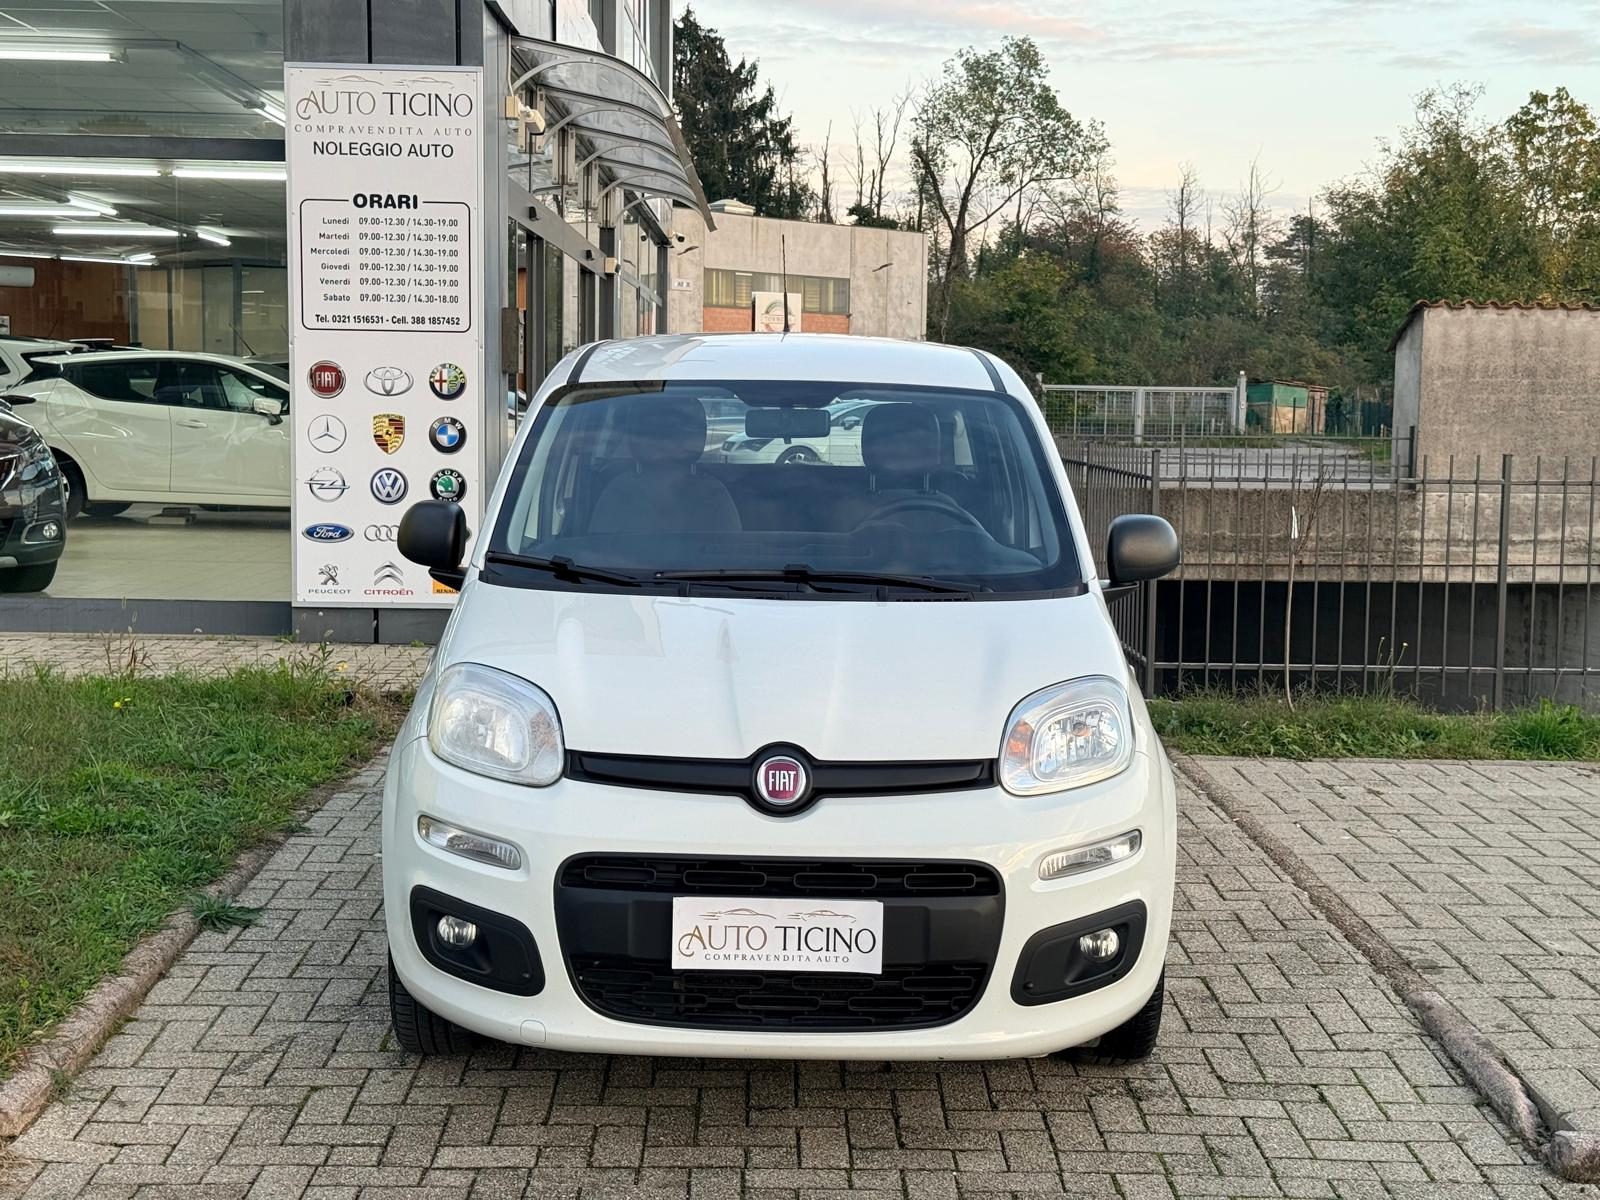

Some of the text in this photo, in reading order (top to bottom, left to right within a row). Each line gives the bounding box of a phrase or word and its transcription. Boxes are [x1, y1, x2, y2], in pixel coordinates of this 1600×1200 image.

[295, 91, 473, 121] AUTO TICINO
[294, 124, 472, 137] COMPRAVENDITA AUTO
[313, 141, 454, 159] NOLEGGIO AUTO
[352, 194, 418, 210] ORARI
[358, 217, 406, 226] 09.00-12.30
[412, 219, 459, 228] 14.30-19.00
[358, 233, 406, 242] 09.00-12.30
[413, 234, 459, 243] 14.30-19.00
[358, 248, 406, 257] 09.00-12.30
[413, 249, 459, 258] 14.30-19.00
[359, 263, 406, 272] 09.00-12.30
[413, 264, 459, 273] 14.30-19.00
[359, 278, 406, 287] 09.00-12.30
[413, 279, 459, 288] 14.30-19.00
[323, 294, 351, 302] Sabato
[359, 294, 406, 303] 09.00-12.30
[413, 295, 459, 304] 14.30-18.00
[314, 314, 330, 323] Tel.
[331, 315, 351, 324] 0321
[352, 315, 384, 325] 1516531
[391, 316, 409, 325] Cell.
[410, 316, 426, 325] 388
[427, 317, 461, 326] 1857452
[316, 372, 337, 388] FIAT
[433, 417, 463, 431] BMW
[313, 526, 342, 539] Ford
[768, 770, 796, 792] FIAT
[678, 925, 877, 957] AUTO TICINO
[704, 954, 850, 964] COMPRAVENDITA AUTO
